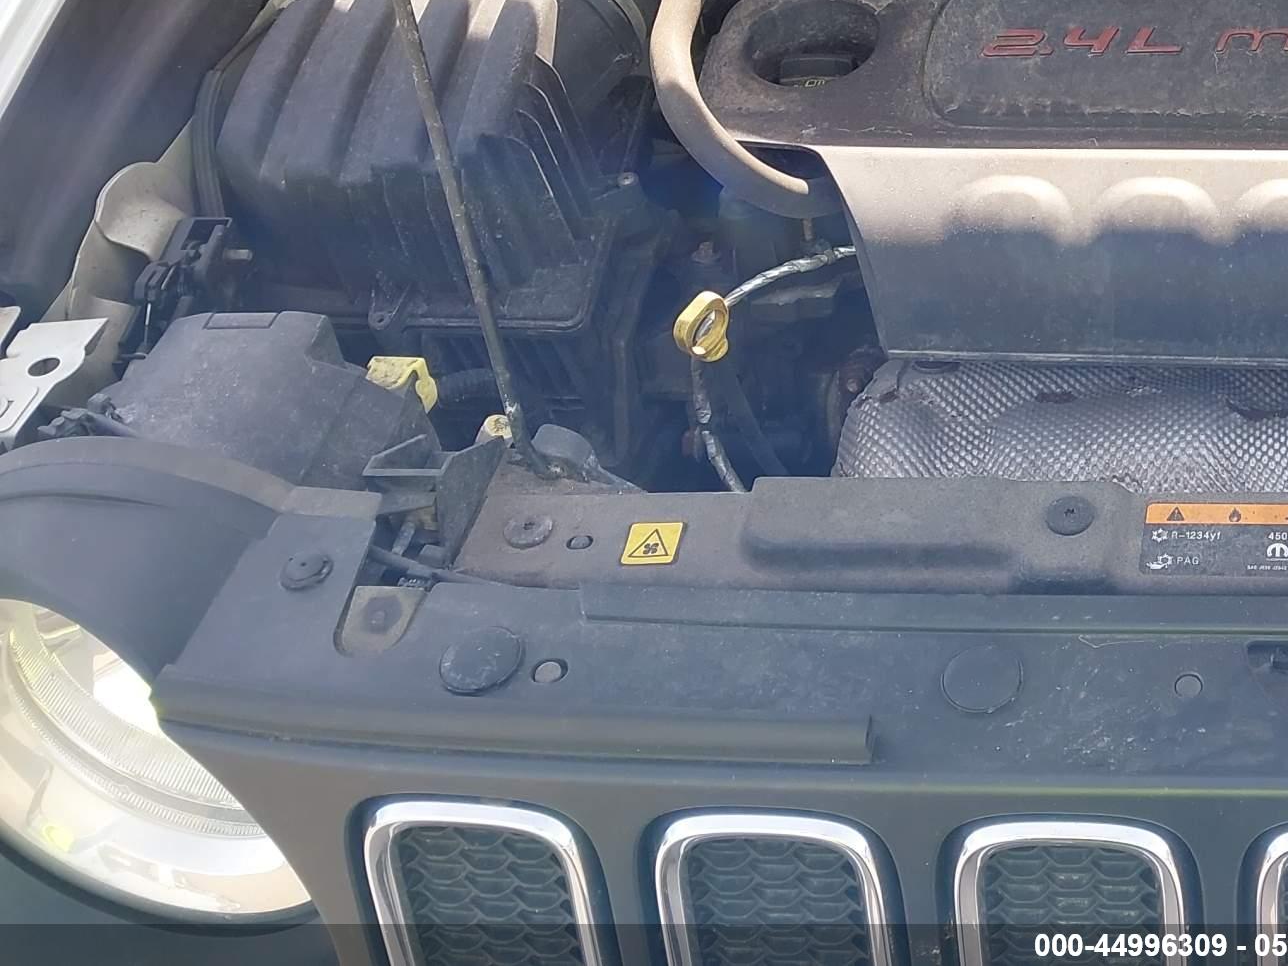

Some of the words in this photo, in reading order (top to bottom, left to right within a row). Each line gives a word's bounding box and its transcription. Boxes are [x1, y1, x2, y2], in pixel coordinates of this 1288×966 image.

[1172, 530, 1221, 542] R-1234yf
[1268, 532, 1288, 540] 450
[1176, 556, 1199, 565] PAG
